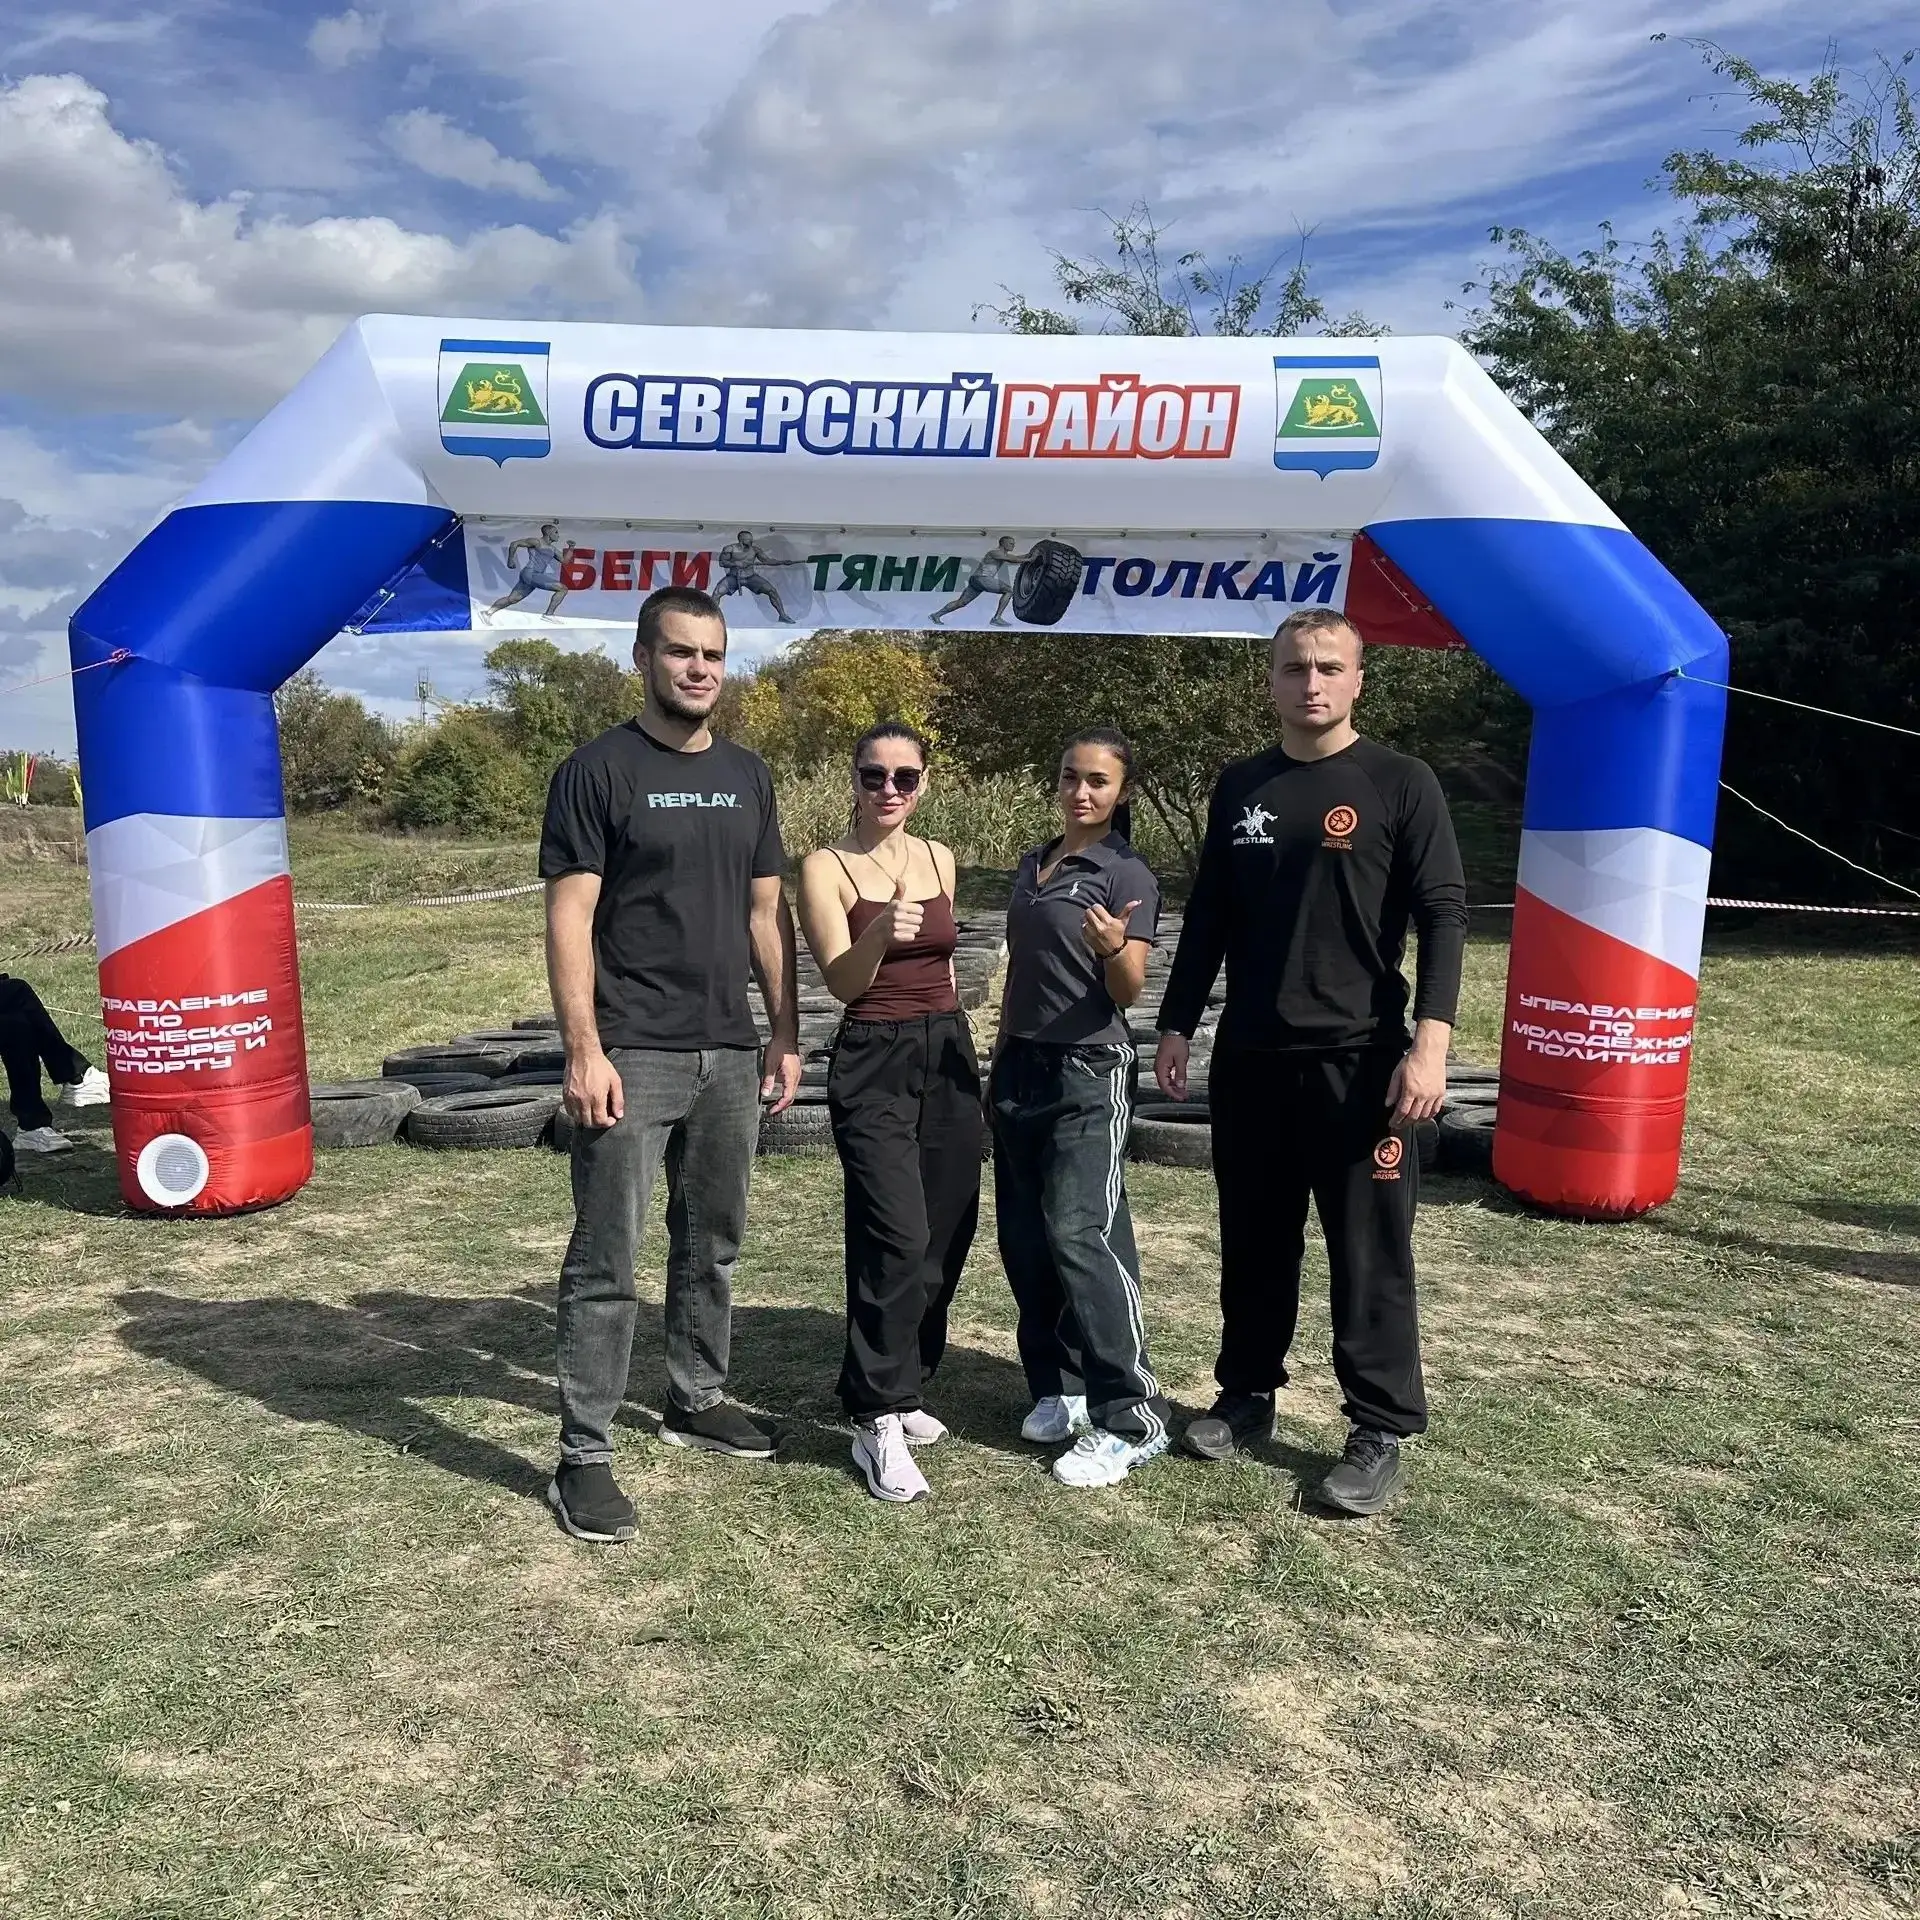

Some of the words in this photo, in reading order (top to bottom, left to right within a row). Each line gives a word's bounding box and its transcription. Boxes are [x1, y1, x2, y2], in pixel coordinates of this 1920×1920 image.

[584, 372, 998, 457] СЕВЕРСКИЙ
[996, 374, 1241, 459] РАЙОН
[559, 547, 713, 592] БЕГИ
[807, 553, 962, 593] ТЯНИ
[1081, 551, 1346, 604] ТОЛКАЙ
[102, 988, 268, 1012] ПРАВЛЕНИЕ
[1520, 993, 1694, 1020] УПРАВЛЕНИЕ
[106, 1014, 273, 1043] ИЗИЧЕСКОЙ
[138, 1014, 183, 1028] ПО
[1589, 1020, 1636, 1033] ПО
[106, 1040, 237, 1059] УЛЬТУРЕ
[245, 1034, 267, 1050] И
[1527, 1040, 1681, 1065] ПОЛИТИКЕ
[115, 1055, 233, 1074] СПОРТУ
